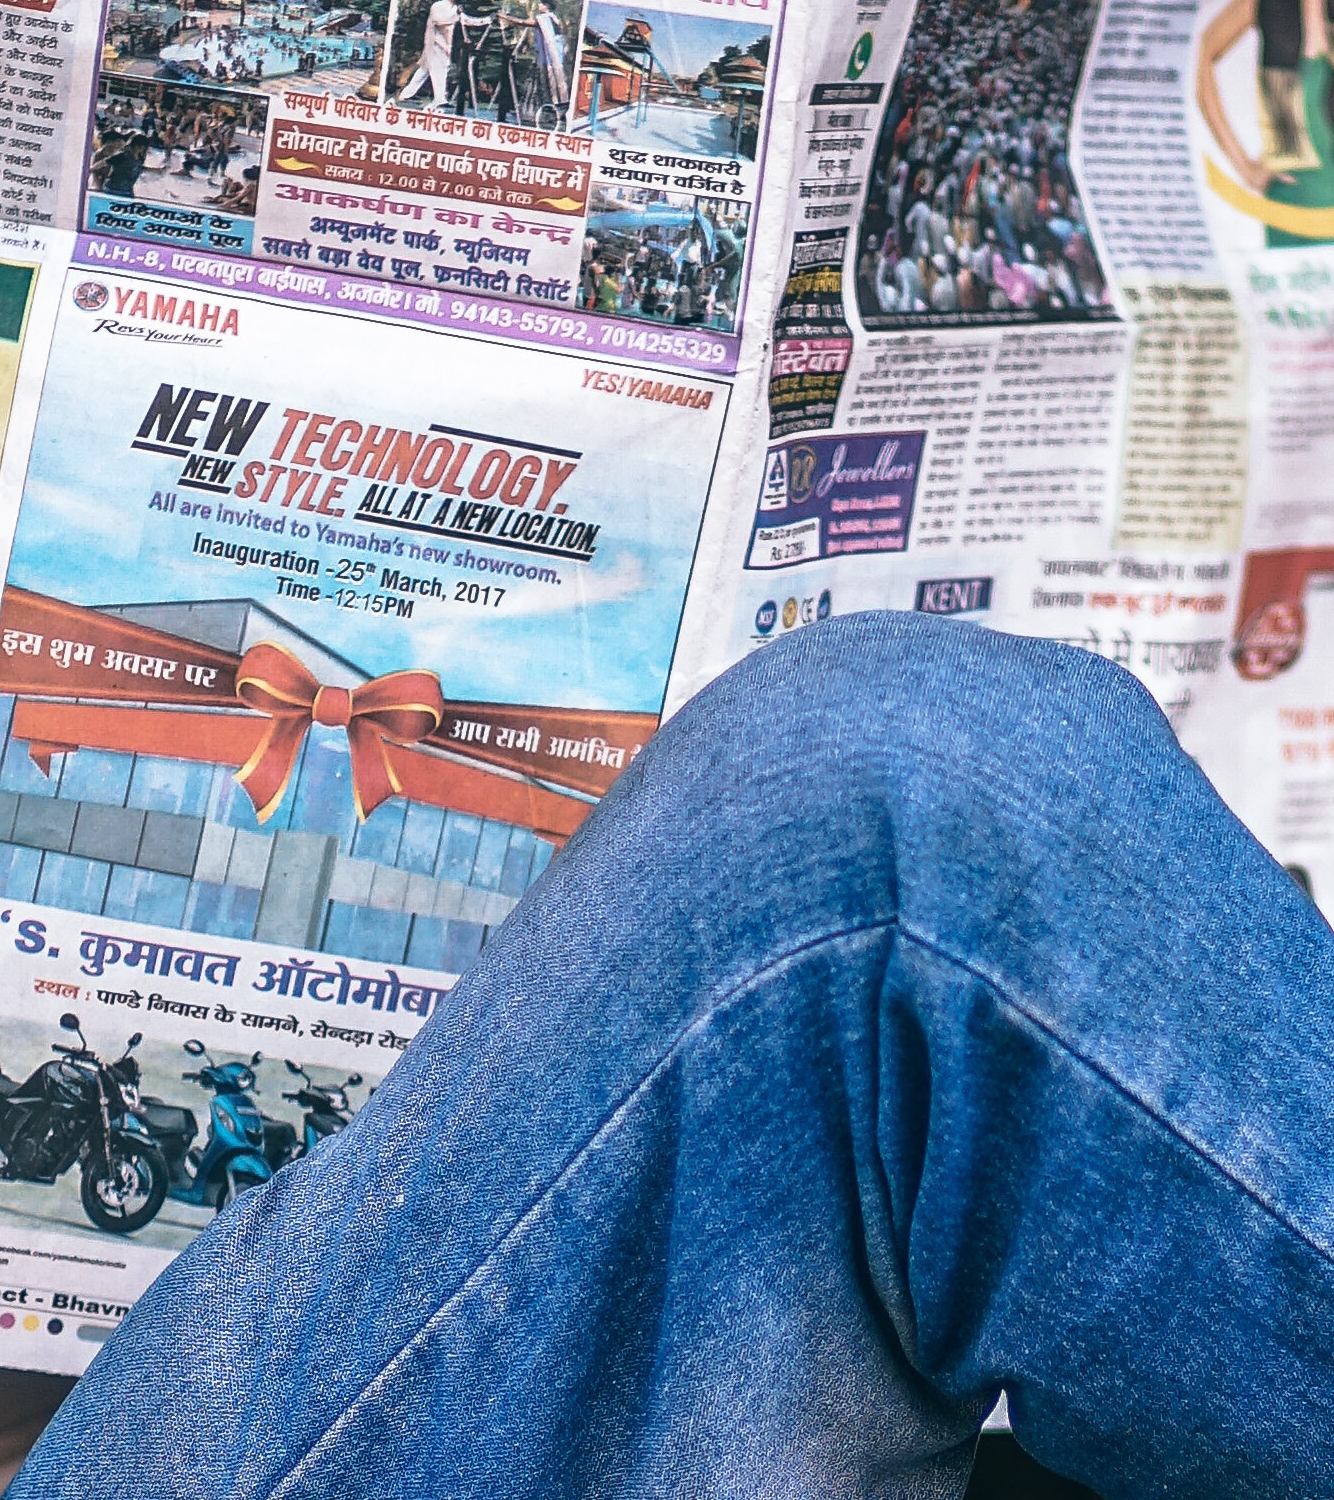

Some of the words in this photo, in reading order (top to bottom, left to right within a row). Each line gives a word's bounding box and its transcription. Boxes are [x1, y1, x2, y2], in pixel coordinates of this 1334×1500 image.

[276, 126, 344, 158] सोमवार
[349, 134, 368, 162] से
[370, 137, 434, 171] रविवार
[437, 149, 474, 177] पार्क
[476, 157, 510, 181] एक
[511, 152, 564, 188] शिफ्ट
[566, 159, 587, 191] में
[274, 183, 427, 221] आकर्षण
[433, 207, 485, 230] का
[490, 211, 575, 246] केन्द्र
[87, 241, 164, 274] N.H.-8,
[172, 252, 254, 288] परबतपुरा
[258, 265, 332, 305] बाईपास,
[337, 281, 411, 318] अजमेर।
[414, 291, 444, 323] मो.
[449, 299, 594, 345] 94143-55792,
[600, 316, 727, 363] 7014255329
[114, 286, 239, 337] YAMAHA
[139, 383, 271, 457] NEW
[269, 408, 578, 515] TECHNOLOGY.
[181, 454, 237, 485] NEW
[233, 461, 349, 518] STYLE.
[359, 483, 394, 515] ALL
[397, 492, 432, 521] AT
[433, 498, 452, 526] A
[452, 502, 500, 533] NEW
[497, 511, 601, 553] LOCATION.
[148, 490, 177, 514] All
[179, 501, 212, 520] are
[216, 502, 287, 535] invited
[290, 519, 311, 539] to
[316, 521, 405, 557] Yamaha's
[408, 543, 451, 565] new
[453, 548, 562, 585] showroom.
[192, 532, 320, 576] Inauguration
[379, 567, 443, 598] March,
[454, 581, 507, 608] 2017
[276, 575, 321, 602] Time
[922, 581, 983, 610] KENT
[1, 628, 44, 656] इस
[50, 638, 96, 669] शुभ
[100, 649, 180, 680] अवसर
[184, 664, 218, 688] पर
[79, 930, 241, 987] कुमावत
[34, 979, 80, 1000] स्थल
[96, 989, 144, 1009] पाण्डे
[146, 992, 211, 1020] निवास
[213, 1003, 237, 1023] के
[241, 1012, 305, 1038] सामने,
[310, 1019, 375, 1048] सेन्दड़ा
